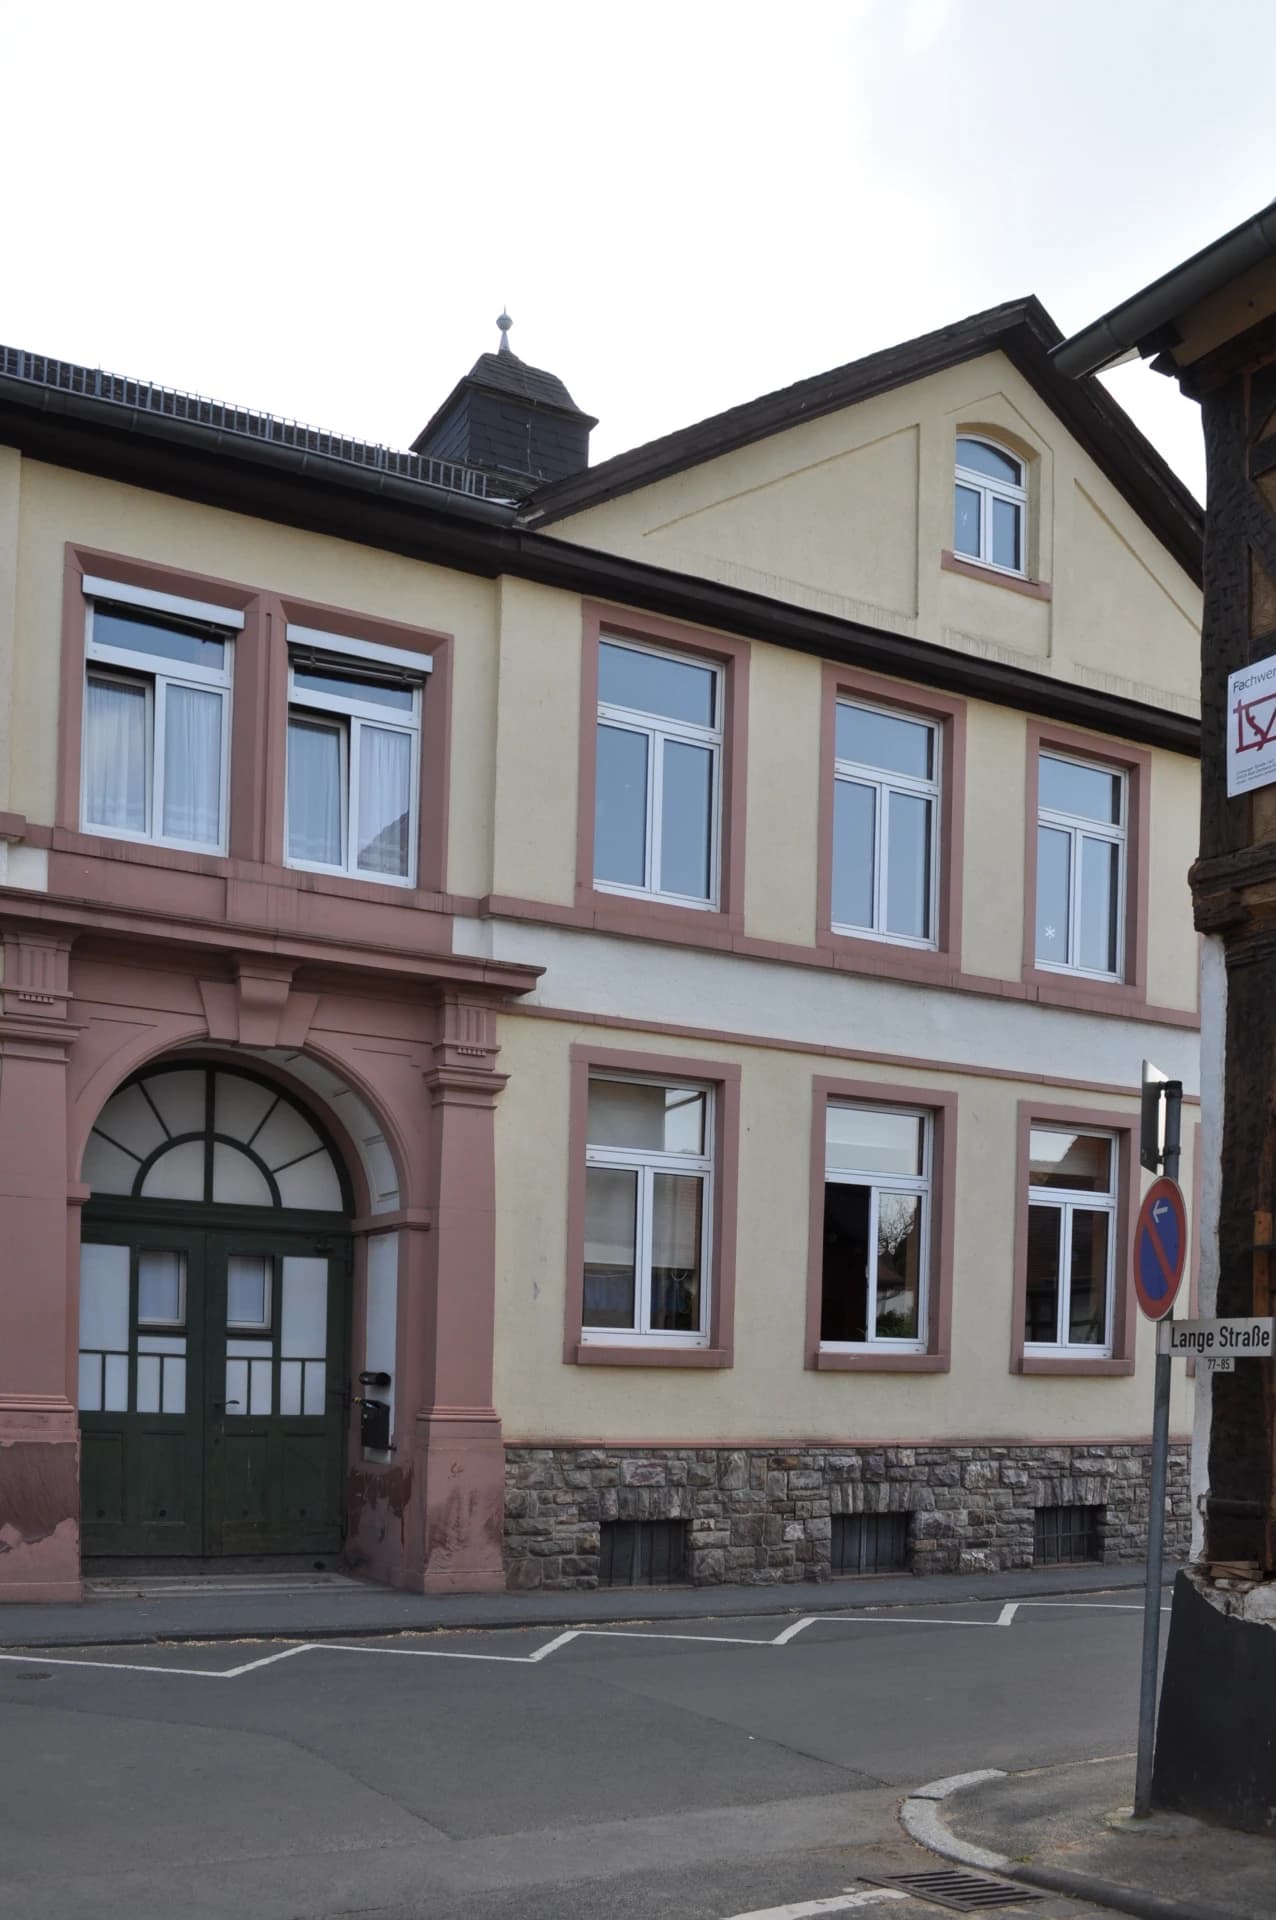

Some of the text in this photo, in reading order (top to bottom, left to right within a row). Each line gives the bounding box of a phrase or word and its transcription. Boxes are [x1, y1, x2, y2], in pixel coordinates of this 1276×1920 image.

[1171, 1325, 1270, 1353] Lange Straße
[1207, 1359, 1230, 1370] 77-85
